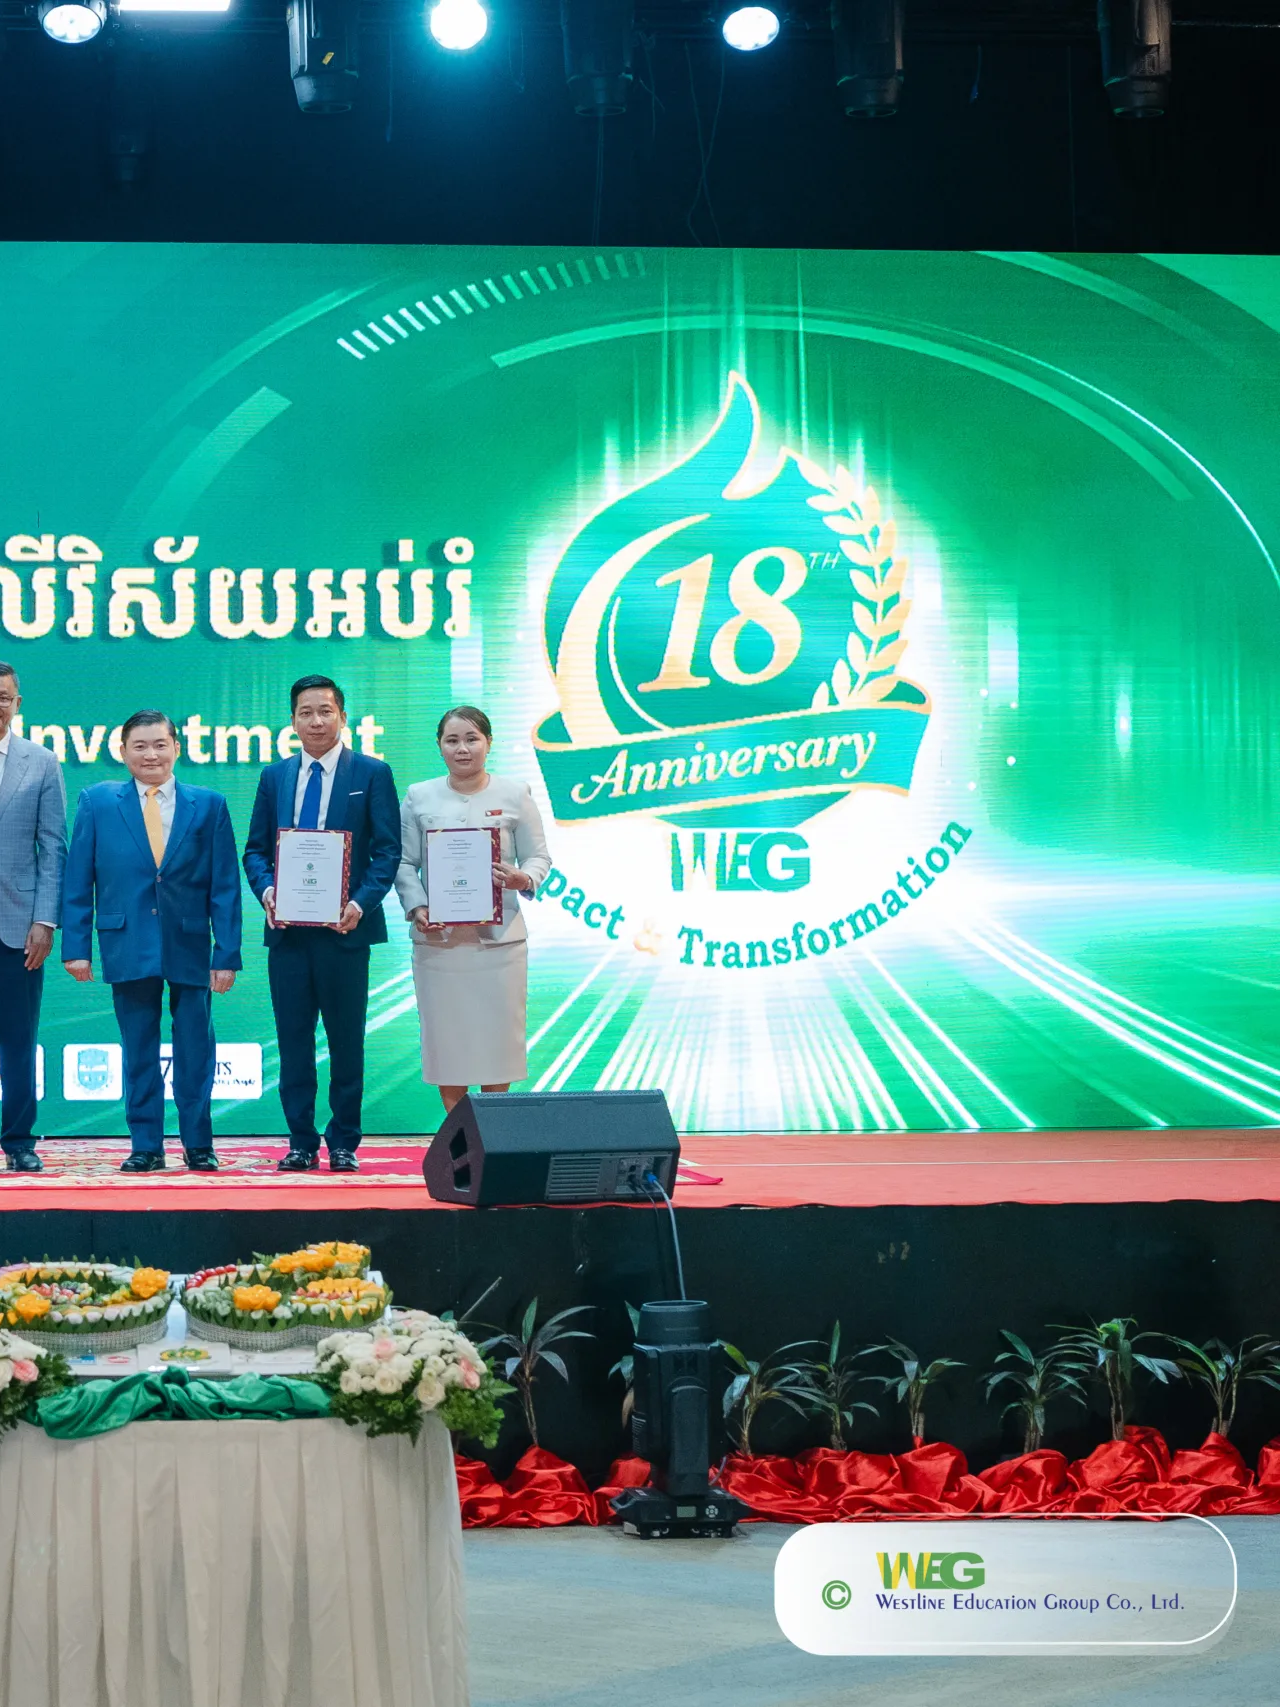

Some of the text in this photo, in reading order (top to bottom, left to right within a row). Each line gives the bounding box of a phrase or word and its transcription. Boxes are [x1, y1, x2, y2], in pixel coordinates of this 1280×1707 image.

[637, 546, 840, 692] 18 TH
[571, 730, 877, 804] Anniversary
[535, 867, 625, 940] pact
[677, 815, 973, 969] Transformation
[665, 831, 811, 893] WEG
